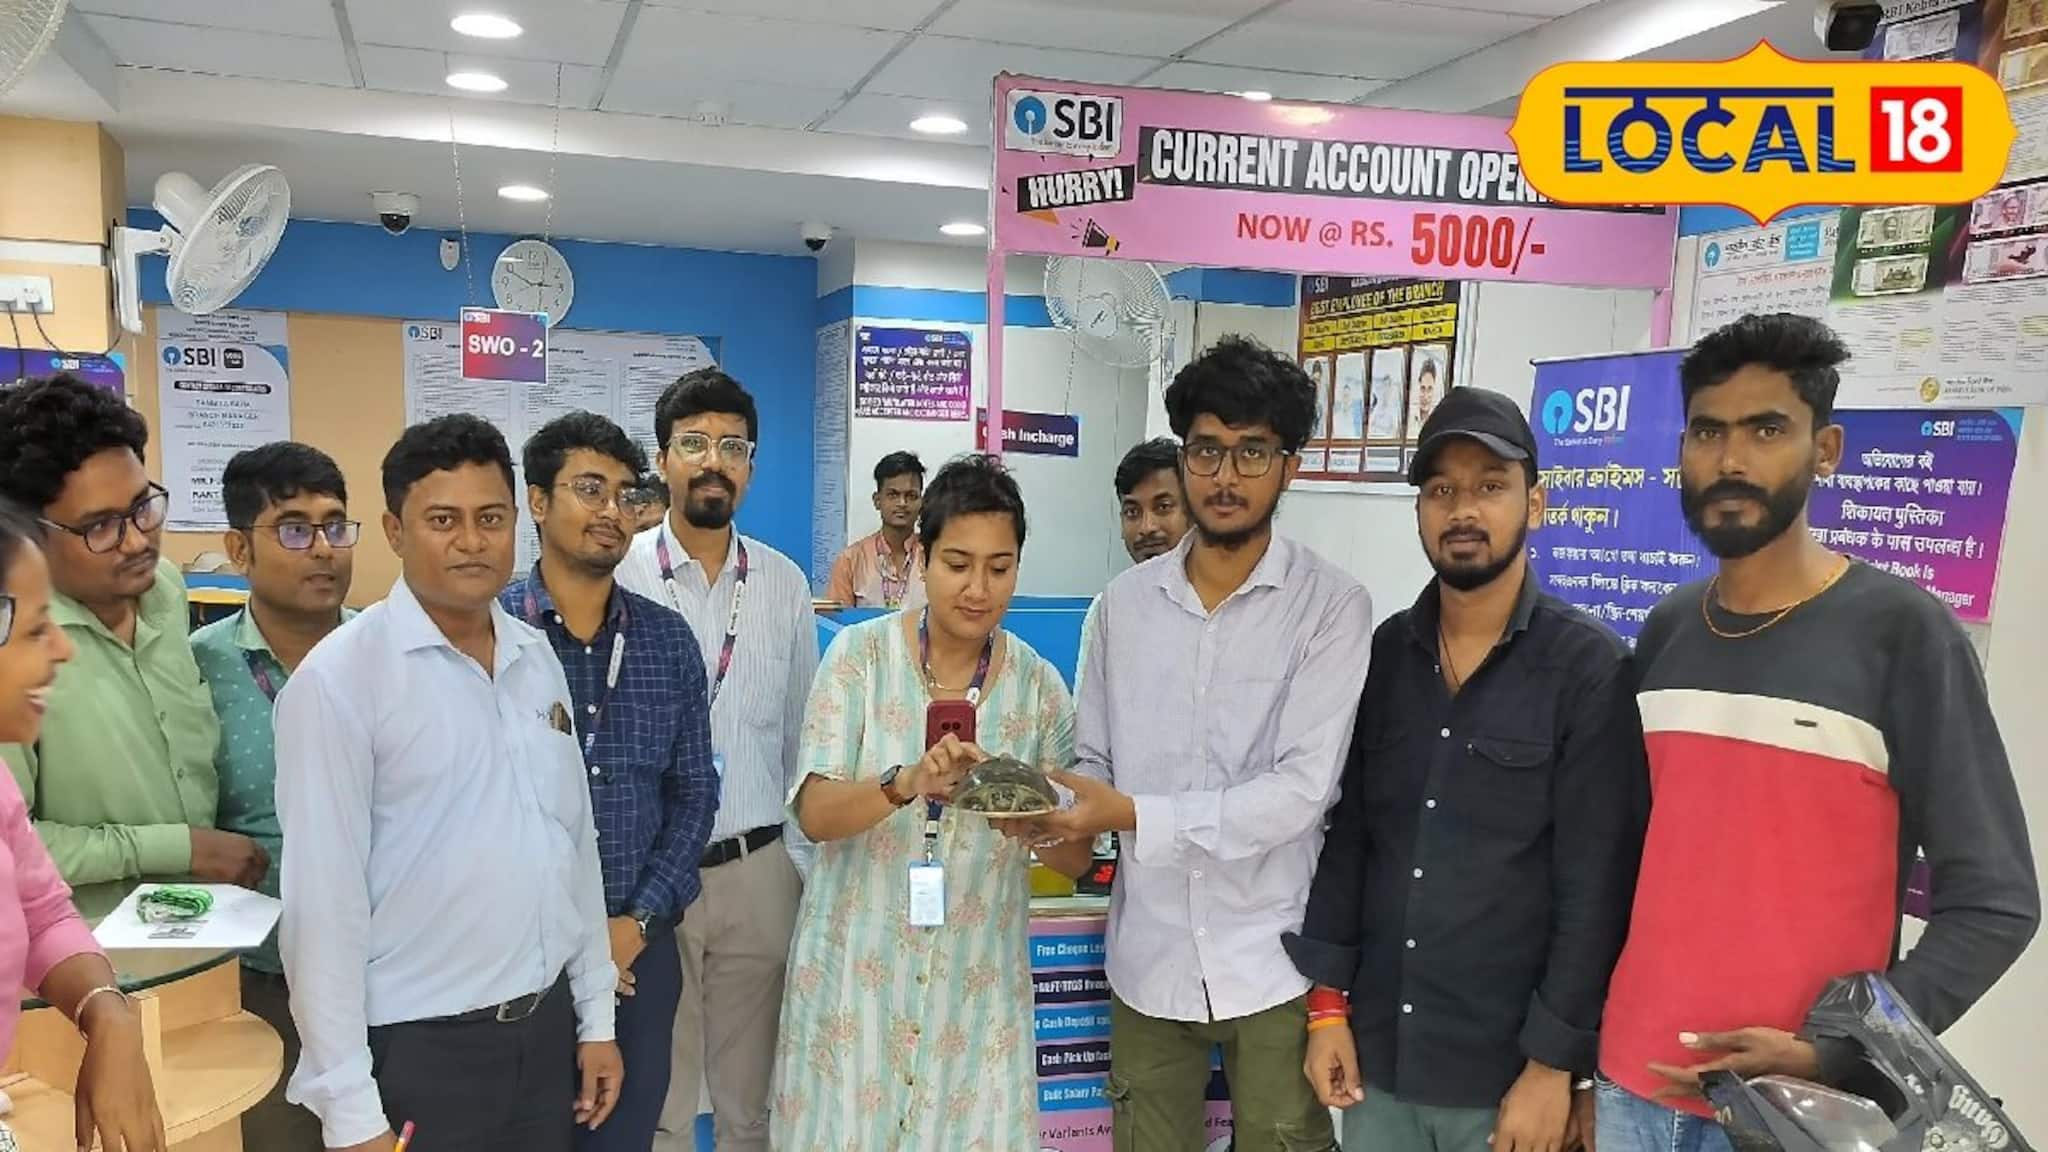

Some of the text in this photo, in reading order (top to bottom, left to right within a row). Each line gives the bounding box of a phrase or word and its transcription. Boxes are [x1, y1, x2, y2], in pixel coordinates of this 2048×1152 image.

[1052, 98, 1114, 142] SBI
[1151, 128, 1299, 188] CURRENT
[1304, 141, 1452, 199] ACCOUNT
[1027, 167, 1124, 209] HURRY!
[1237, 212, 1545, 275] NOW @ RS. 5000/-
[184, 347, 216, 367] SBI
[468, 334, 515, 356] SWO
[531, 339, 544, 358] 2
[1573, 384, 1631, 433] SBI
[1018, 428, 1075, 448] Incharge
[1933, 420, 1955, 436] SBI
[1840, 499, 1946, 529] शिकायत पुस्तिका
[1871, 527, 1884, 549] के
[1887, 533, 1913, 553] पास
[1890, 561, 1921, 579] Book
[1037, 944, 1056, 957] Free
[1049, 1126, 1095, 1140] Variants
